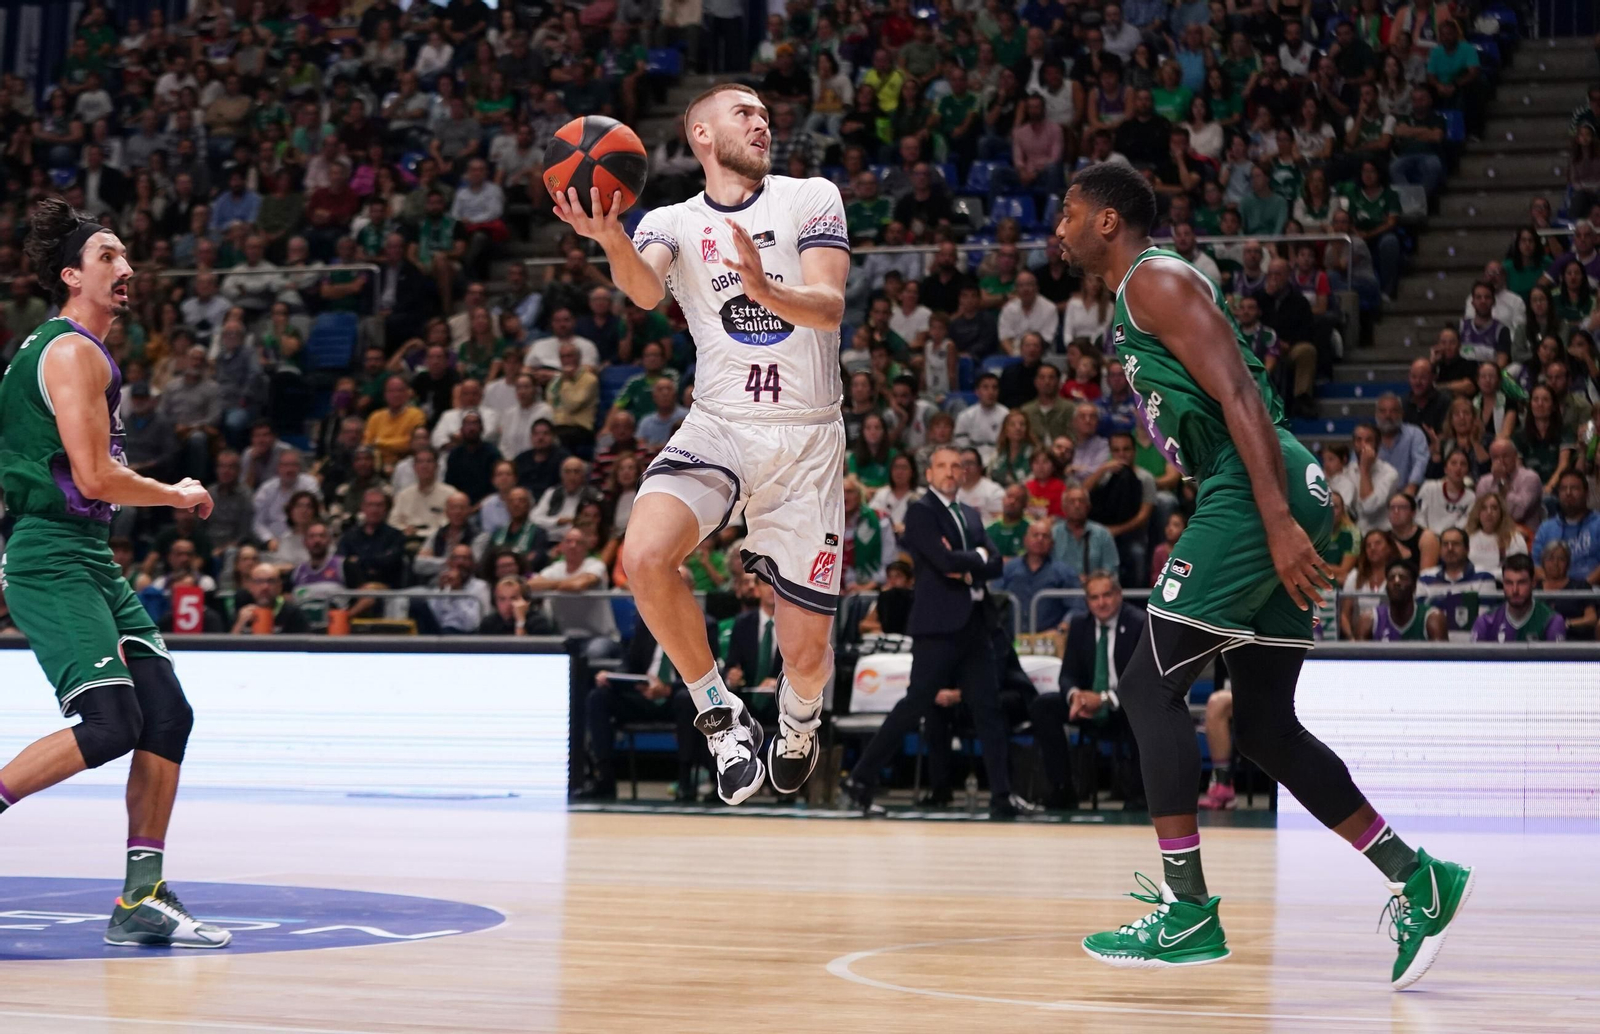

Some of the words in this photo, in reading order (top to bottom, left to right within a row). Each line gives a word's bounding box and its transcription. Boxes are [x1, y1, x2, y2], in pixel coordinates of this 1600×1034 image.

[730, 304, 778, 318] Estre
[733, 316, 783, 332] Galicia
[745, 363, 782, 403] 44
[176, 594, 200, 630] 5
